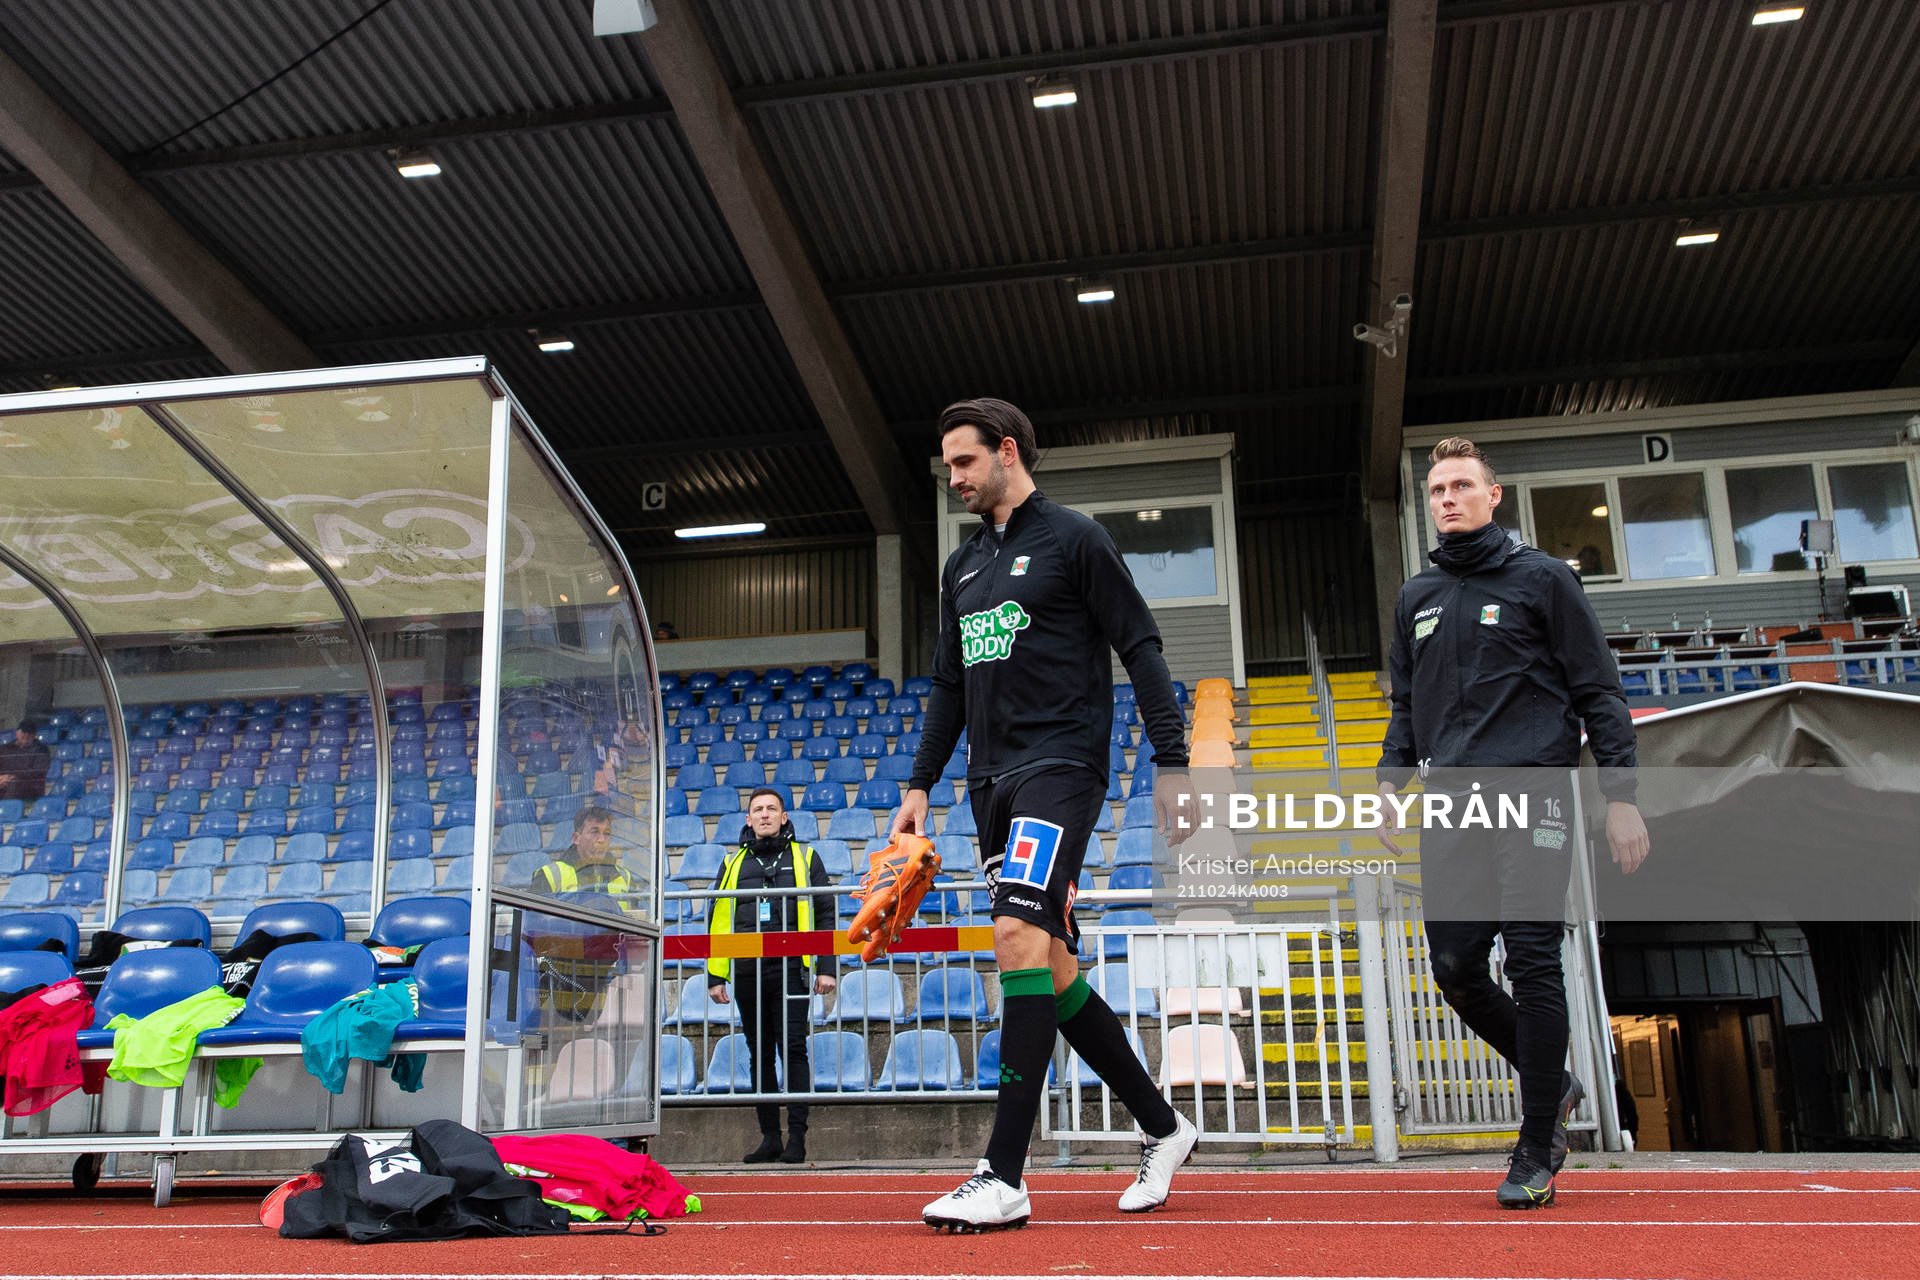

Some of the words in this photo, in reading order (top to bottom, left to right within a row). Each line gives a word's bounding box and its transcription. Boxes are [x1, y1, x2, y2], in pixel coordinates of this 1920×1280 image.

[1646, 436, 1669, 462] D
[645, 484, 663, 508] C
[961, 634, 1010, 662] UDDY
[1417, 757, 1432, 778] 16
[1544, 797, 1562, 819] 16
[1540, 819, 1562, 829] CRAFT
[1008, 896, 1037, 909] CRAFT
